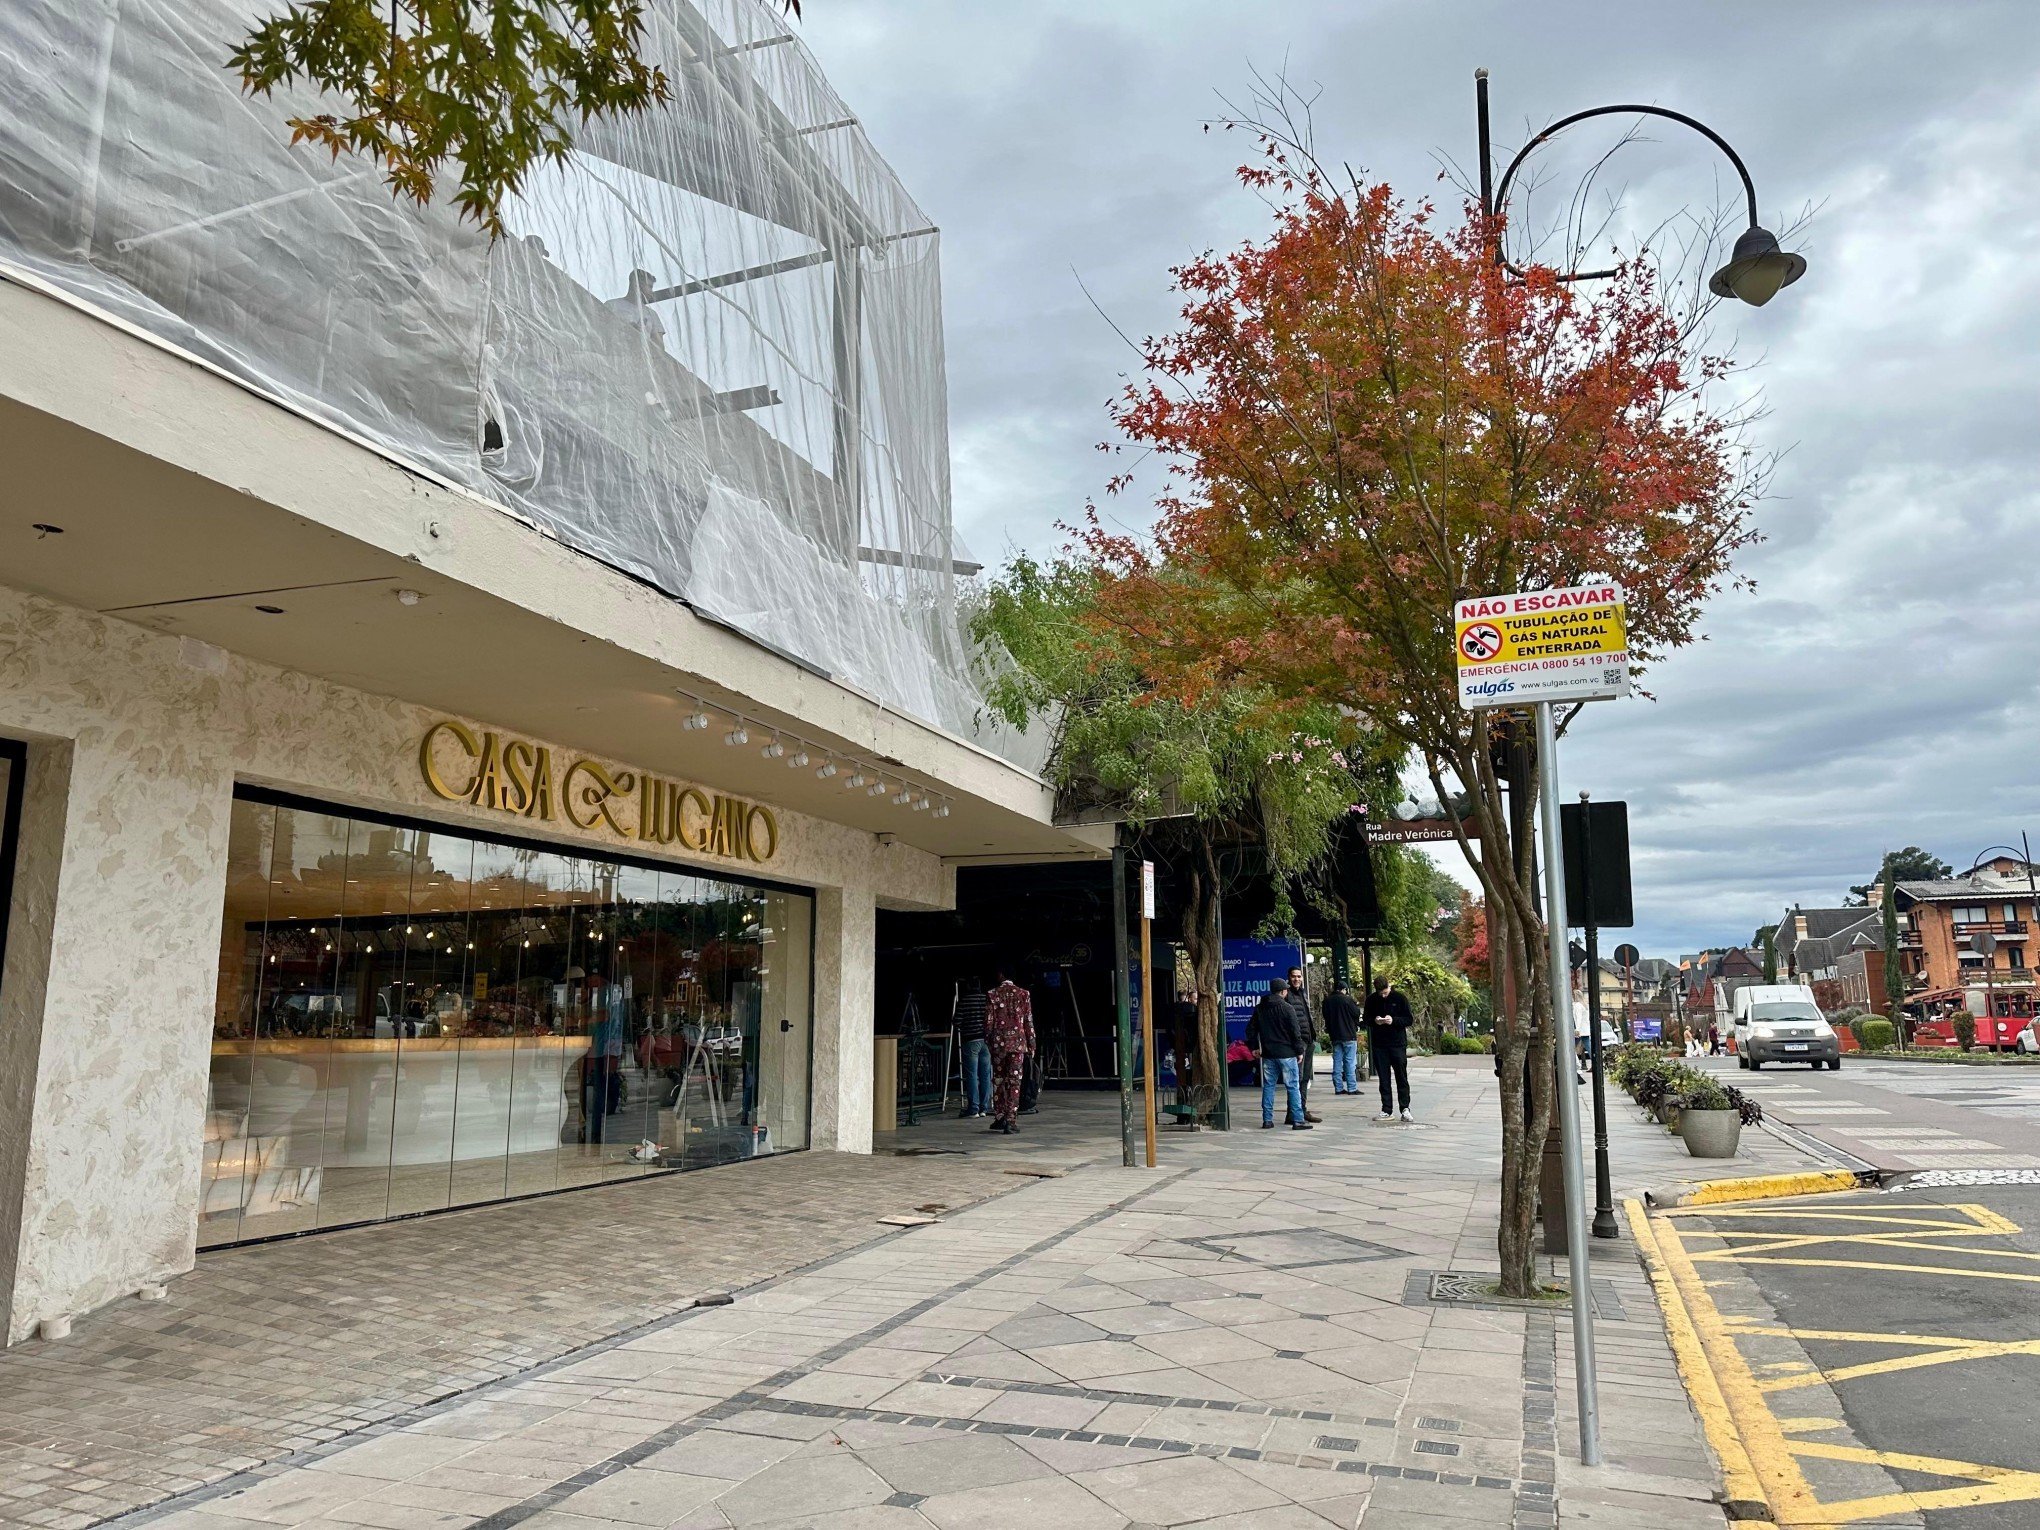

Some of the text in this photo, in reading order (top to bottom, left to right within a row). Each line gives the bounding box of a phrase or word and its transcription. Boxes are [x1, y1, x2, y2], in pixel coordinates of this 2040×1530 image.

[1462, 587, 1616, 619] NÃO ESCAVAR
[1504, 609, 1612, 630] TUBULAÇÃO DE
[1510, 624, 1607, 643] GÁS NATURAL
[1517, 639, 1602, 657] ENTERRADA
[1460, 653, 1627, 678] EMERGÊNCIA 0800 54 19 700
[1465, 677, 1515, 697] sulgás
[419, 722, 778, 863] CASA & LUGANO
[1365, 823, 1382, 831] Rua
[1368, 828, 1453, 841] Madre Verônica
[1224, 980, 1271, 993] LIZE AQUI
[1225, 995, 1262, 1008] DENCIA
